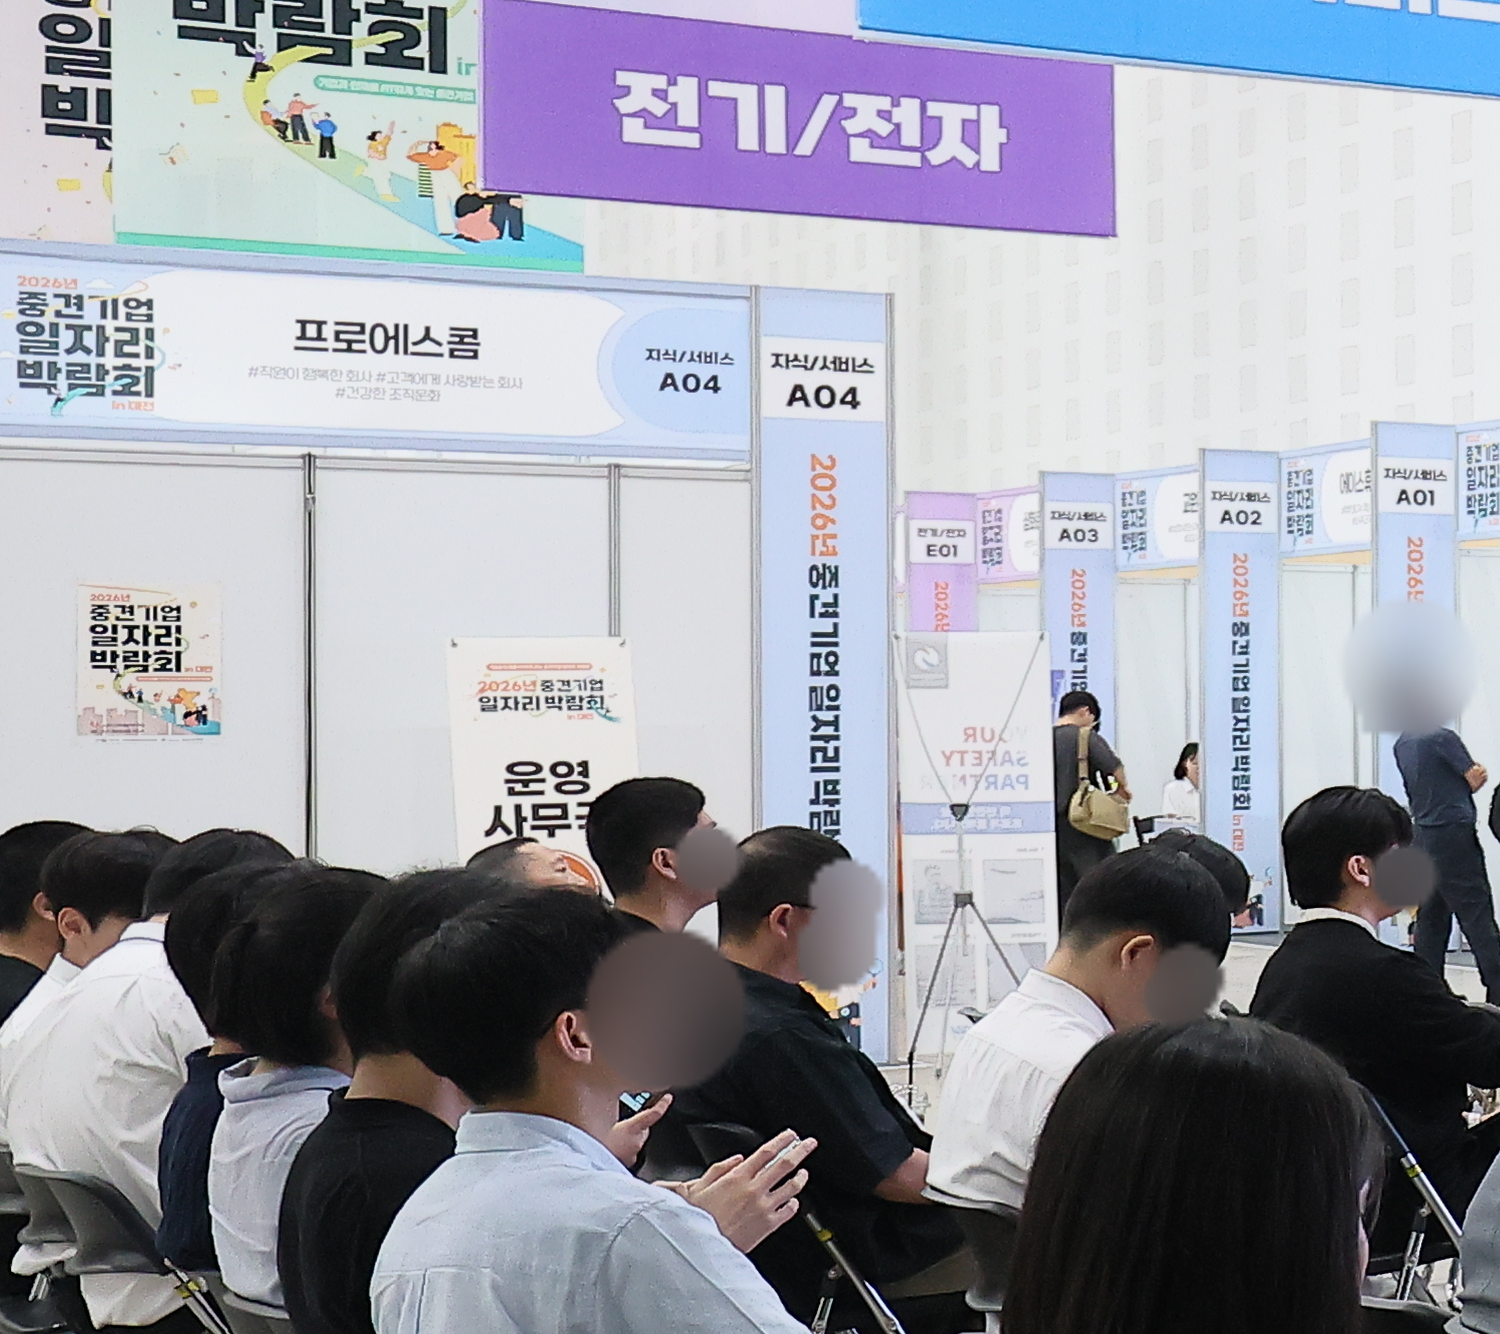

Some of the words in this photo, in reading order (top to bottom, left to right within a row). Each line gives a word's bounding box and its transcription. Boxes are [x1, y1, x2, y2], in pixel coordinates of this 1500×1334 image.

[611, 68, 1009, 174] 전기/전자
[17, 275, 78, 290] 2026년
[17, 291, 153, 323] 중견기업
[16, 320, 155, 360] 일자리
[292, 317, 481, 361] 프로에스콤
[645, 347, 736, 367] 지식/서비스
[771, 352, 875, 376] 지식/서비스
[17, 359, 155, 398] 박람회
[658, 372, 722, 395] A04
[786, 383, 861, 410] A04
[809, 453, 838, 557] 2026년
[1396, 489, 1435, 506] A01
[1220, 510, 1262, 525] A02
[1059, 528, 1099, 543] A03
[926, 544, 958, 558] E01
[1071, 568, 1087, 628] 2026년
[1232, 553, 1250, 618] 2026년
[89, 604, 181, 622] 중견기업
[808, 563, 840, 678] 중견기업
[89, 623, 182, 647] 일자리
[89, 650, 182, 673] 박람회
[1231, 621, 1251, 692] 중견기업
[477, 680, 537, 692] 2026년
[540, 679, 604, 693] 중견기업
[478, 695, 540, 713] 일자리
[545, 695, 605, 711] 박람회
[808, 683, 841, 774] 일자리
[1231, 695, 1251, 754] 일자리
[504, 760, 591, 796] 운영
[1231, 755, 1251, 811] 박람회
